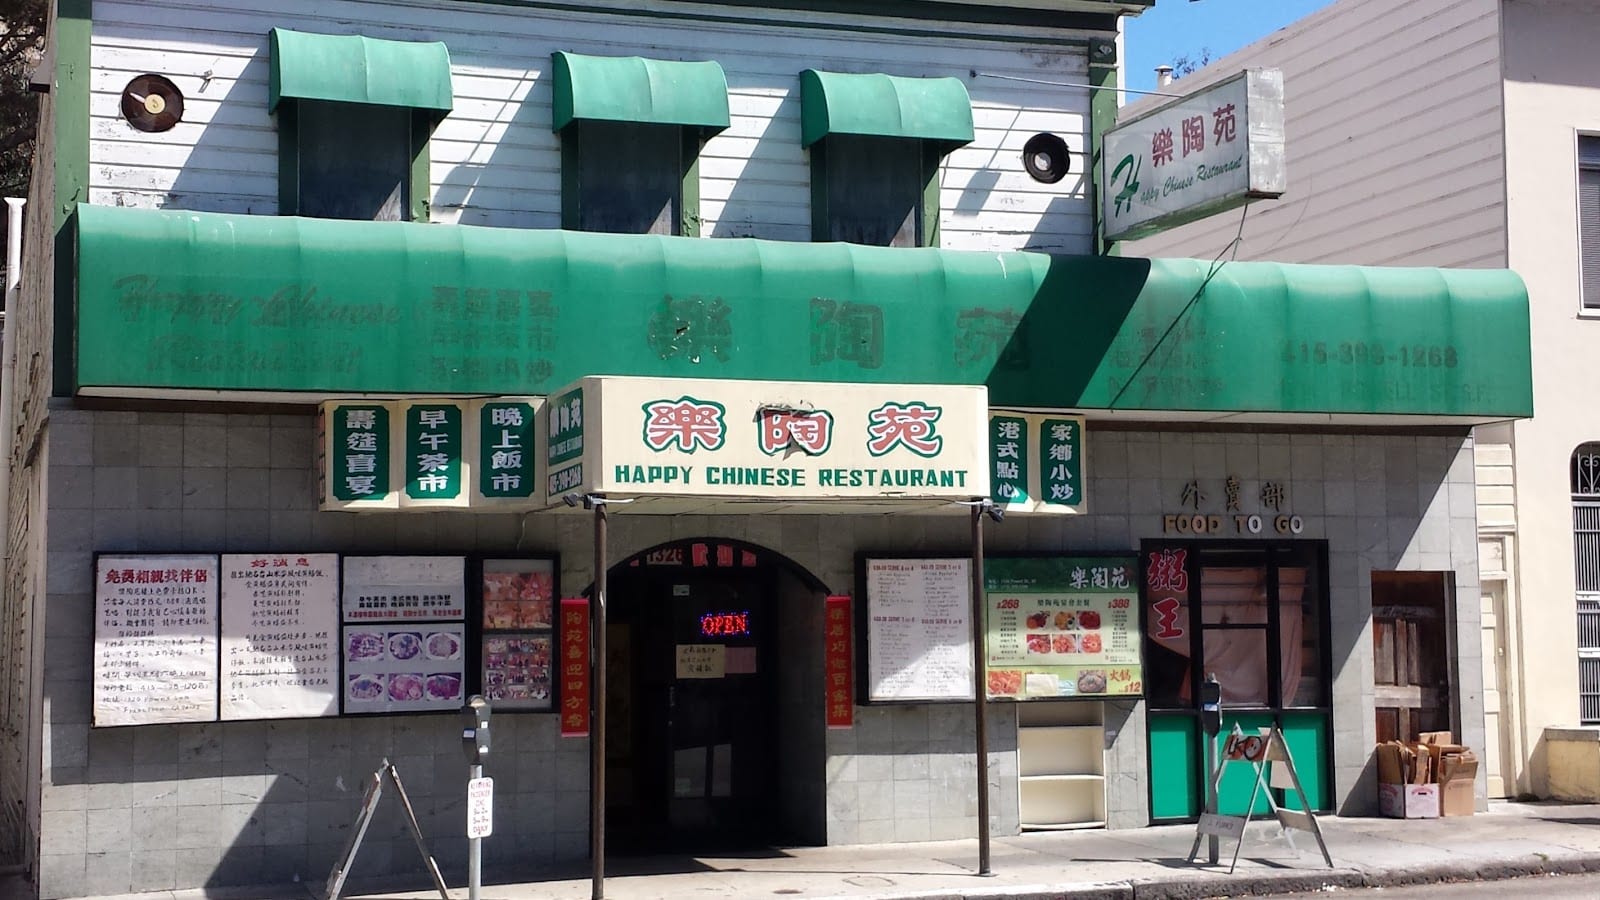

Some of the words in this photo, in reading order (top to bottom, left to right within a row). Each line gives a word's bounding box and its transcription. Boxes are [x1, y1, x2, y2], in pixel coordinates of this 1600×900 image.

[1152, 103, 1236, 168] 樂陶苑
[1110, 152, 1159, 218] Happy
[1163, 175, 1194, 198] Chinese
[1196, 154, 1243, 182] Restaurant
[345, 410, 377, 495] 壽筵喜宴
[417, 410, 449, 493] 早午茶市
[491, 407, 523, 492] 晚上飯市
[642, 395, 942, 457] 樂陶苑
[615, 465, 693, 484] HAPPY
[706, 467, 806, 487] CHINESE
[818, 468, 969, 488] RESTAURANT
[996, 421, 1020, 499] 港式點心
[1049, 424, 1074, 500] 家鄉小炒
[1164, 514, 1224, 534] FOOD
[1233, 514, 1263, 534] TO
[1274, 514, 1304, 534] GO
[1181, 475, 1284, 512] 外賣部
[104, 568, 208, 584] 免費相親找伴侶
[648, 549, 684, 563] 1326
[1069, 566, 1130, 590] 樂陶苑
[703, 615, 746, 634] OPEN
[1147, 548, 1188, 639] 粥王
